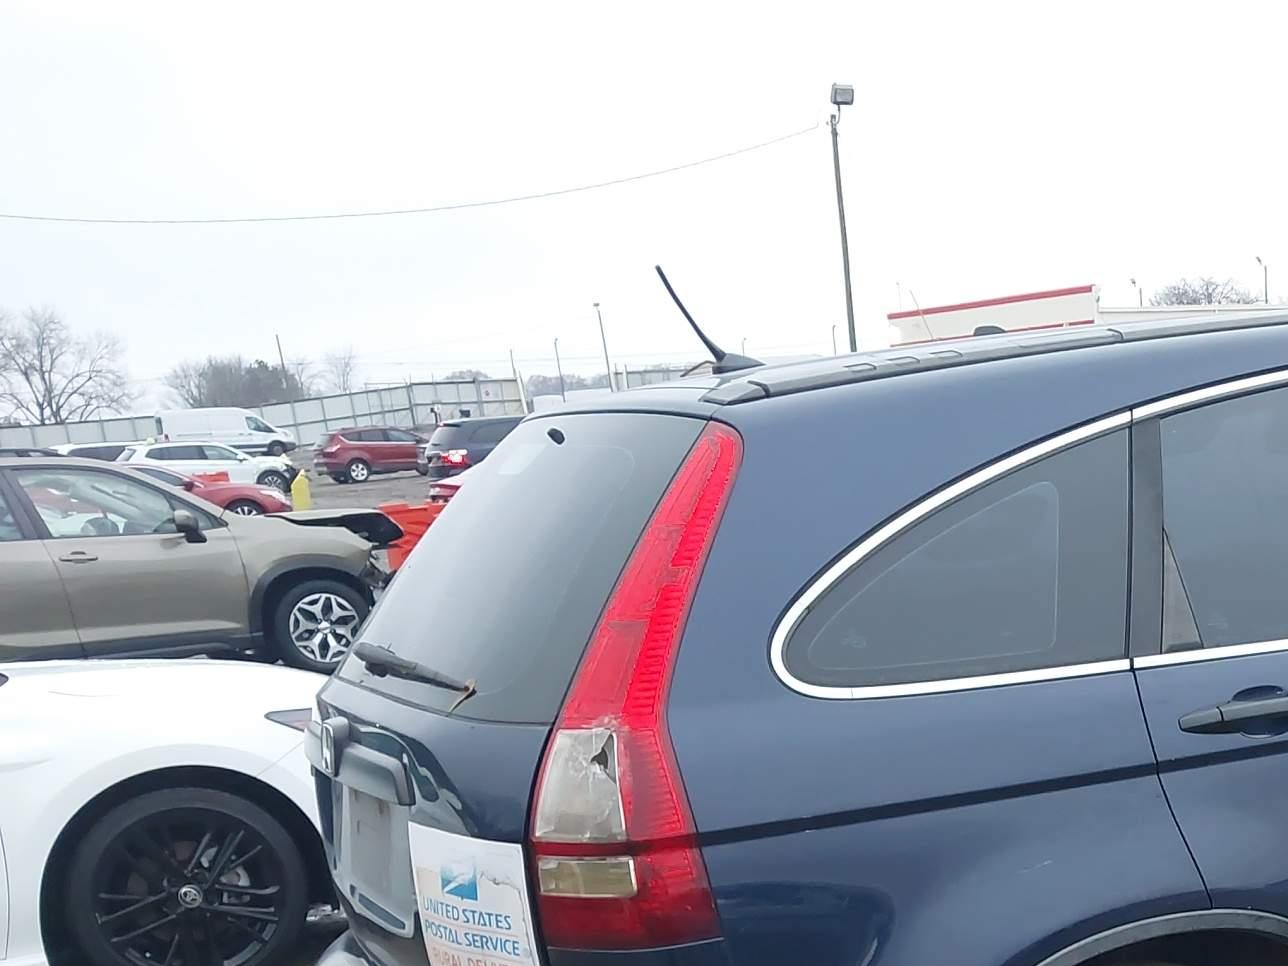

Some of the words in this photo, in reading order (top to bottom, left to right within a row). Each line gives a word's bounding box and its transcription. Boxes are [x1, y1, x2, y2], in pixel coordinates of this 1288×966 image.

[422, 896, 460, 921] UNITED
[462, 909, 512, 930] STATES
[424, 920, 463, 945] POSTAL
[464, 932, 521, 956] SERVICE
